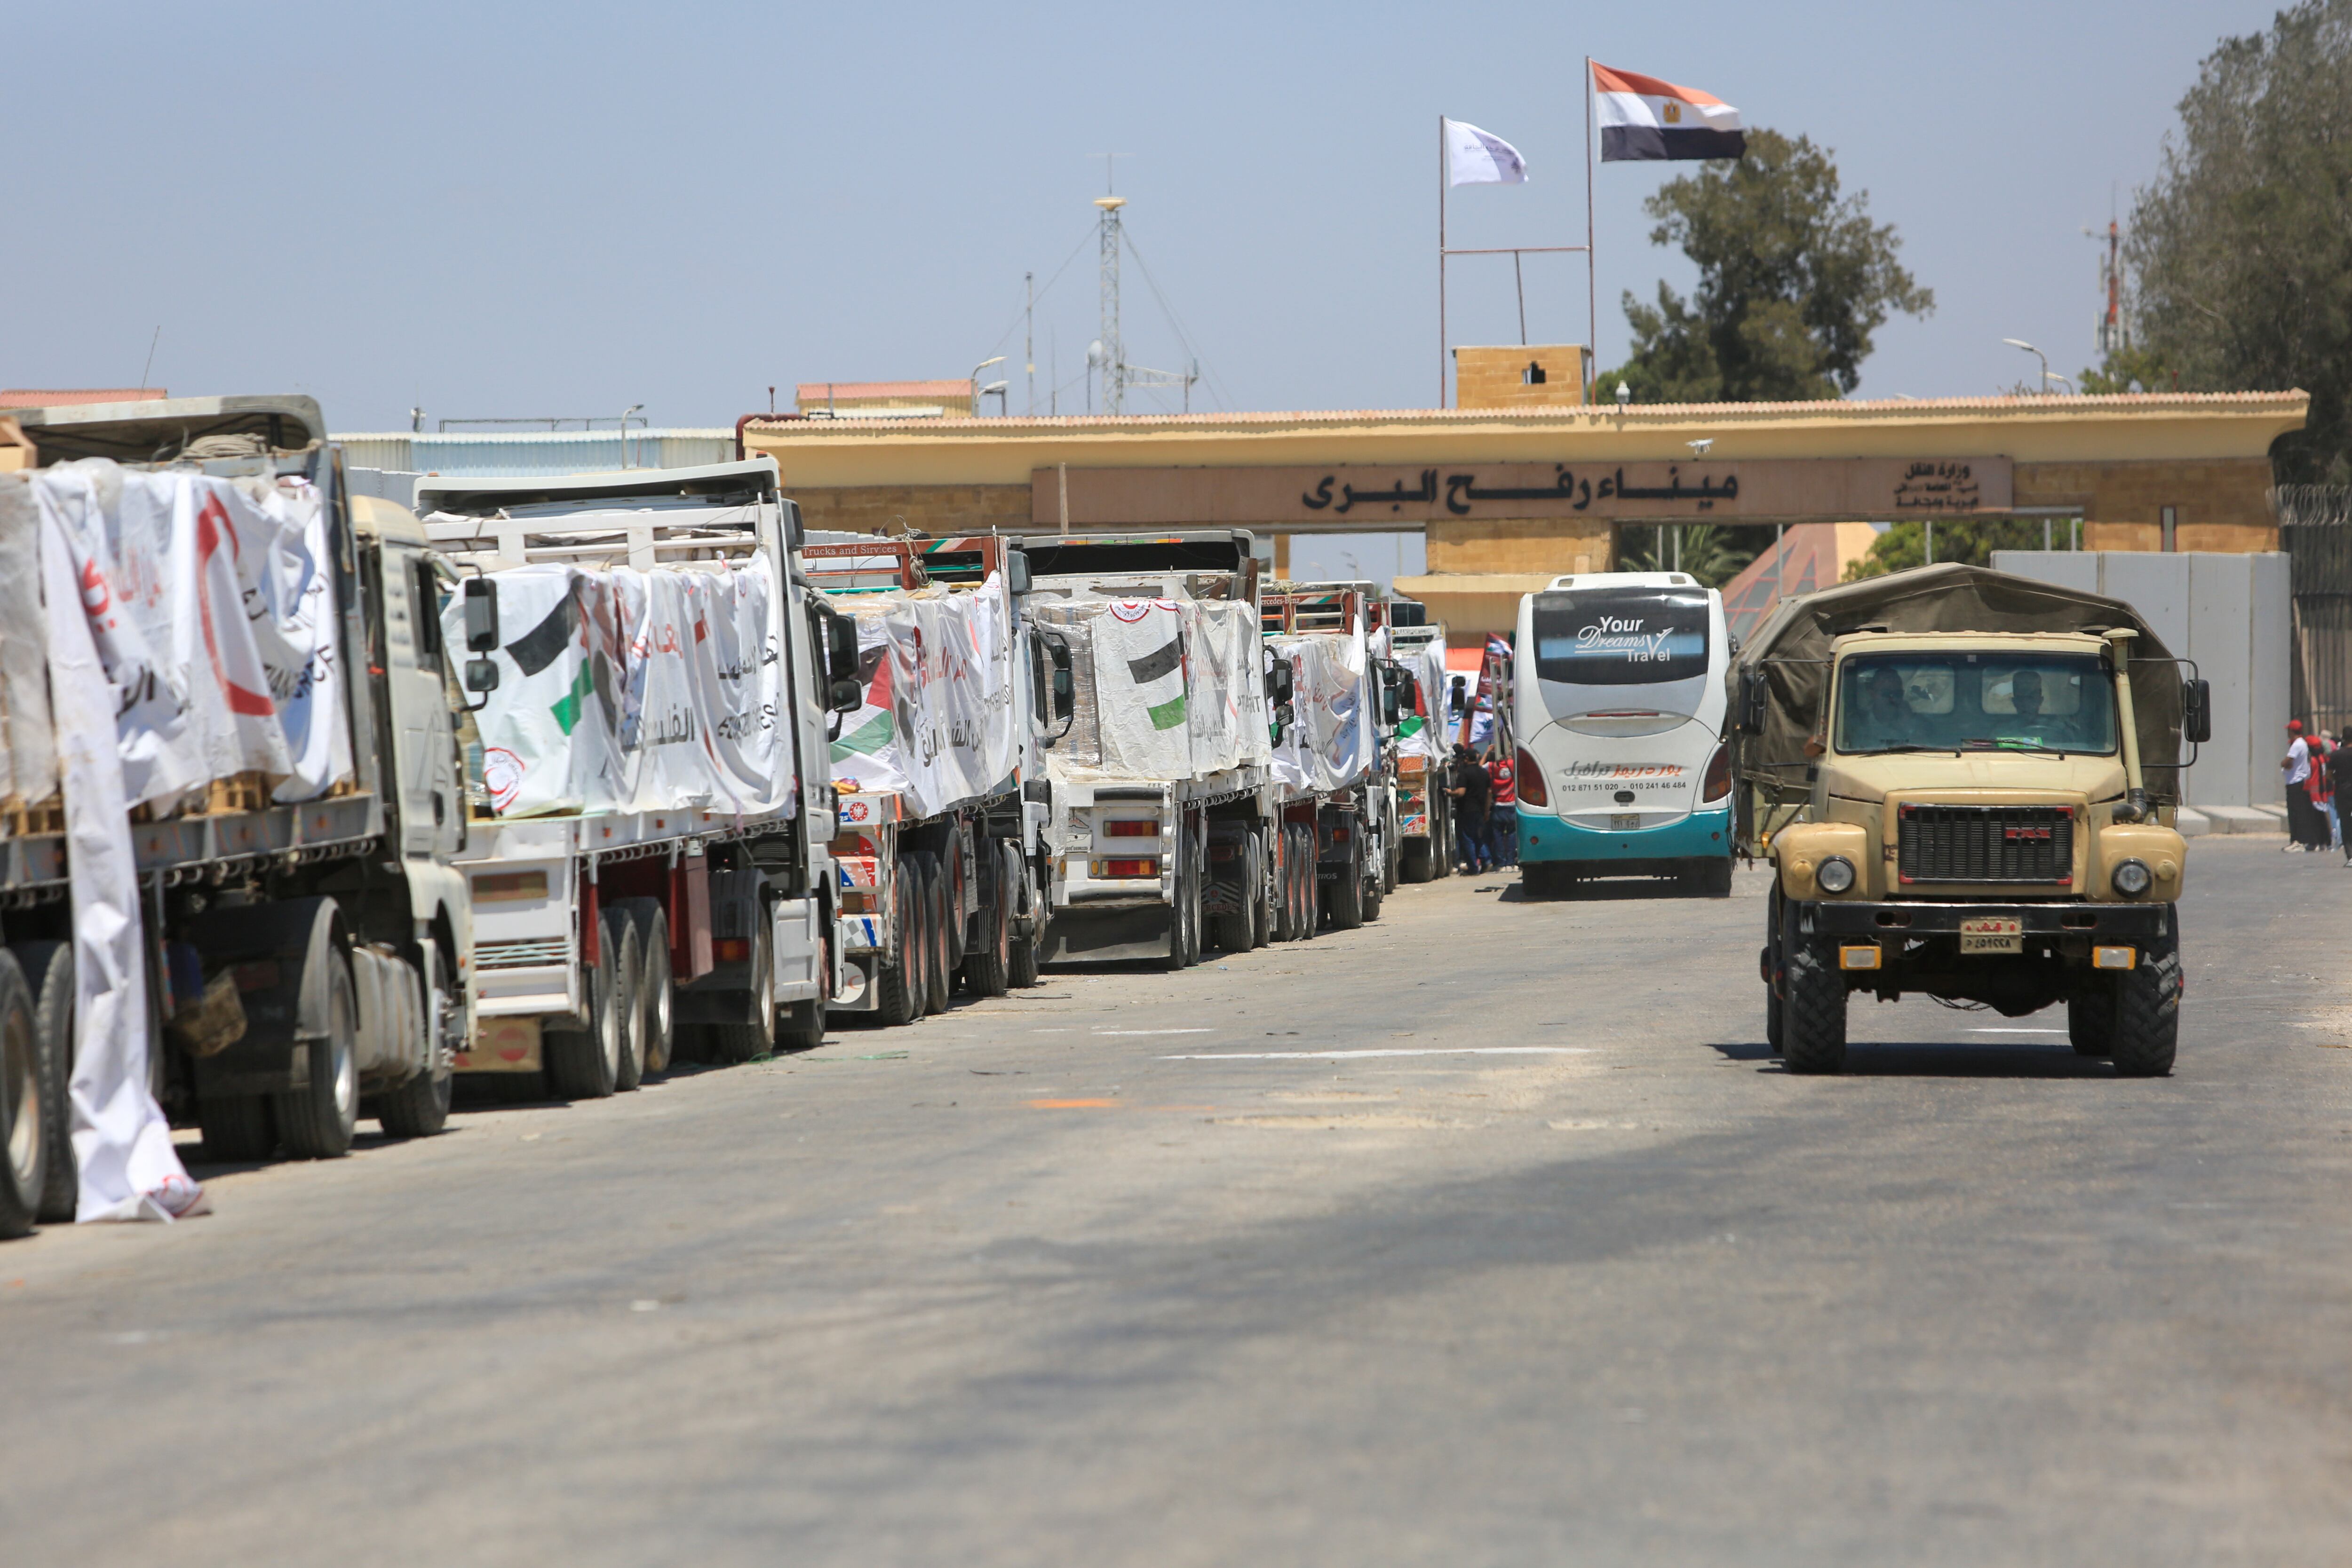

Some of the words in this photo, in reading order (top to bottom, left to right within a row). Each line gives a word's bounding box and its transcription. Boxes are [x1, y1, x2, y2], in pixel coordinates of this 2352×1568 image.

[1446, 463, 1591, 514] رفح
[1597, 466, 1738, 510] ميناء
[803, 546, 835, 556] Trucks
[839, 546, 857, 555] and
[1261, 596, 1301, 605] ercedes-Bnz
[1600, 616, 1644, 633] Your
[1575, 625, 1646, 648] Dreams
[1201, 903, 1237, 911] ERCEDES
